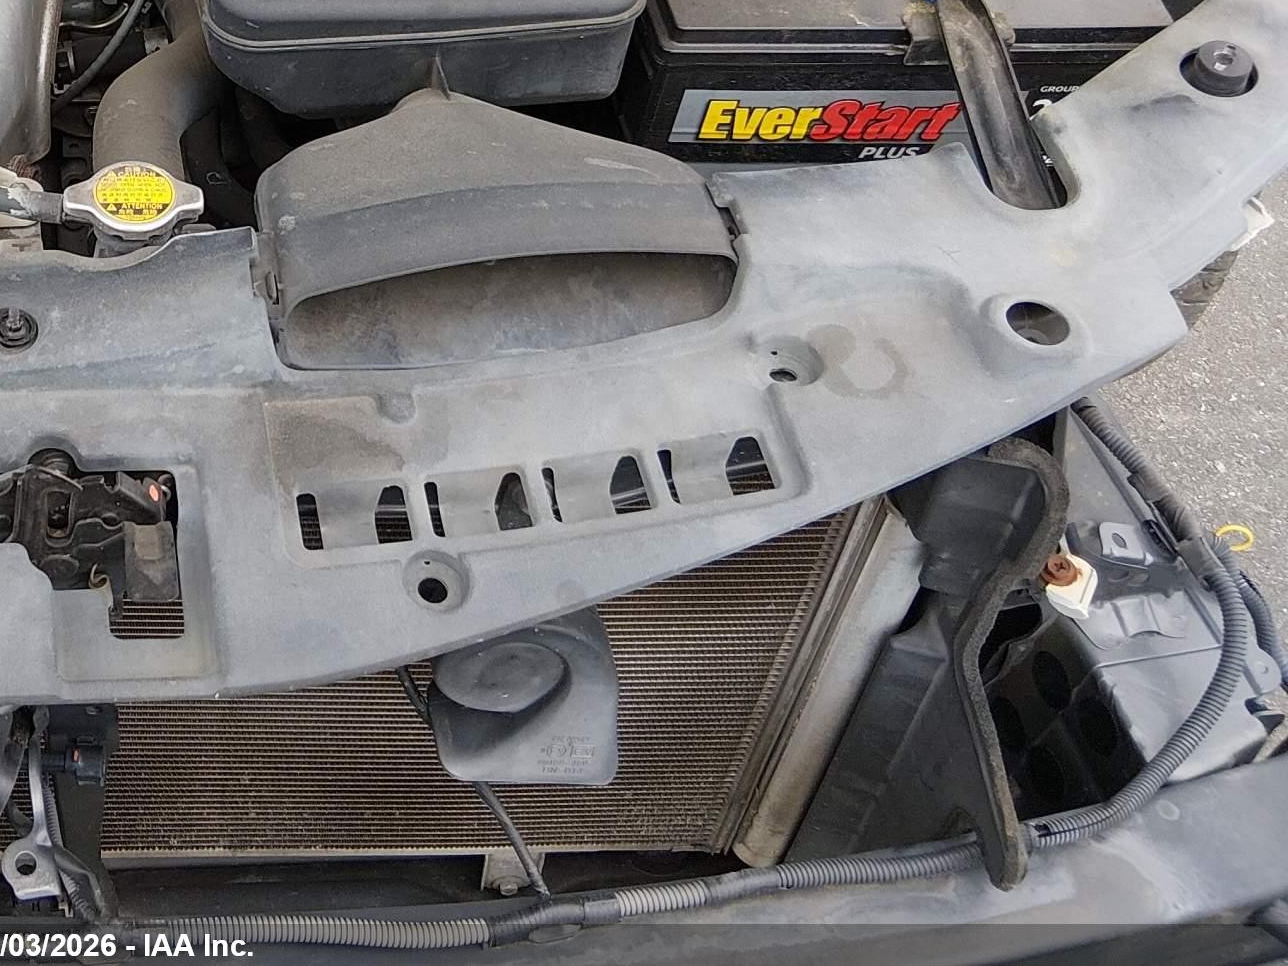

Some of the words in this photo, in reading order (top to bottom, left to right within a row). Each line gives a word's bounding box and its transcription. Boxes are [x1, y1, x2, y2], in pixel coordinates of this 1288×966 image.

[1040, 85, 1080, 93] GROUP
[697, 99, 961, 142] EverStart
[859, 146, 921, 159] PLUS
[121, 202, 163, 210] ATTENTION
